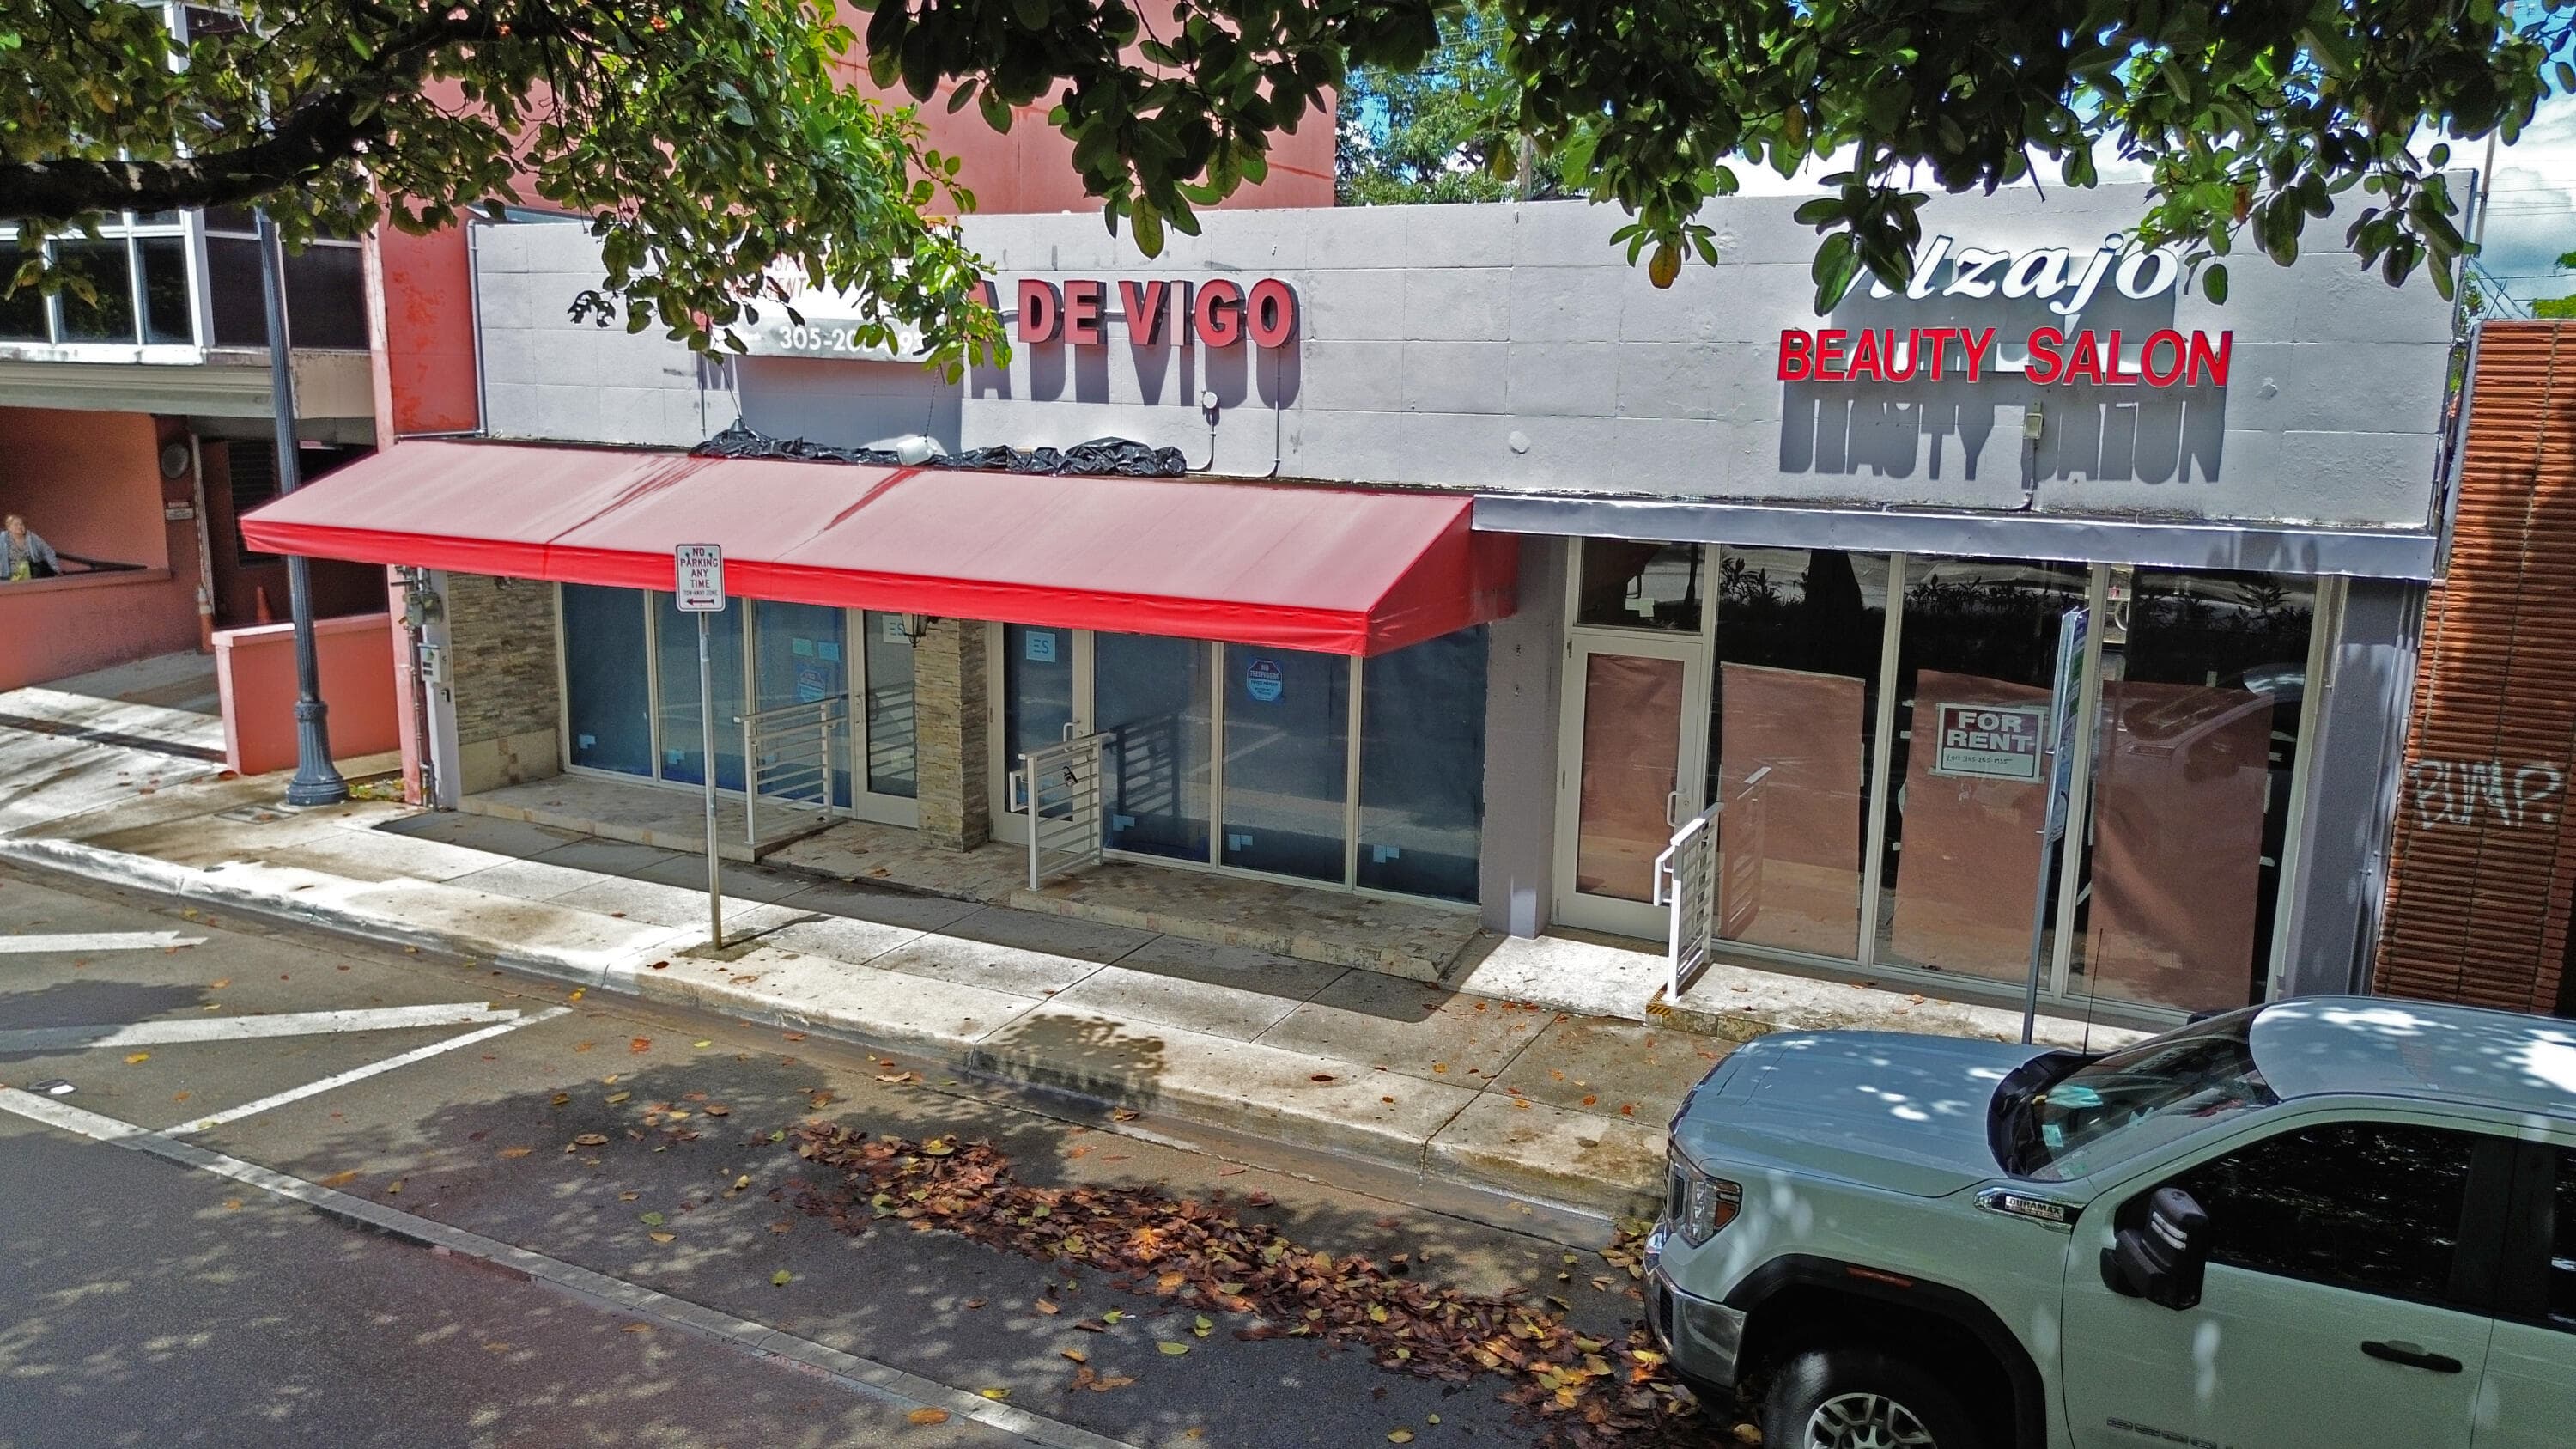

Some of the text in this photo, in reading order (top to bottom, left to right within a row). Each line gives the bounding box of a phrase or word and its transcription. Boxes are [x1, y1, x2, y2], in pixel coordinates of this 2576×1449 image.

[1840, 232, 2180, 316] lzajo
[1018, 278, 1104, 345] DE
[1118, 277, 1295, 348] VIGO
[1777, 326, 2233, 389] BEAUTY SALON
[692, 547, 705, 557] NO
[680, 558, 719, 568] PARKING
[690, 579, 711, 588] TIME
[691, 569, 708, 578] ANY
[1958, 710, 2023, 733] FOR
[1946, 728, 2034, 752] RENT
[2009, 1197, 2061, 1215] DURAMAX
